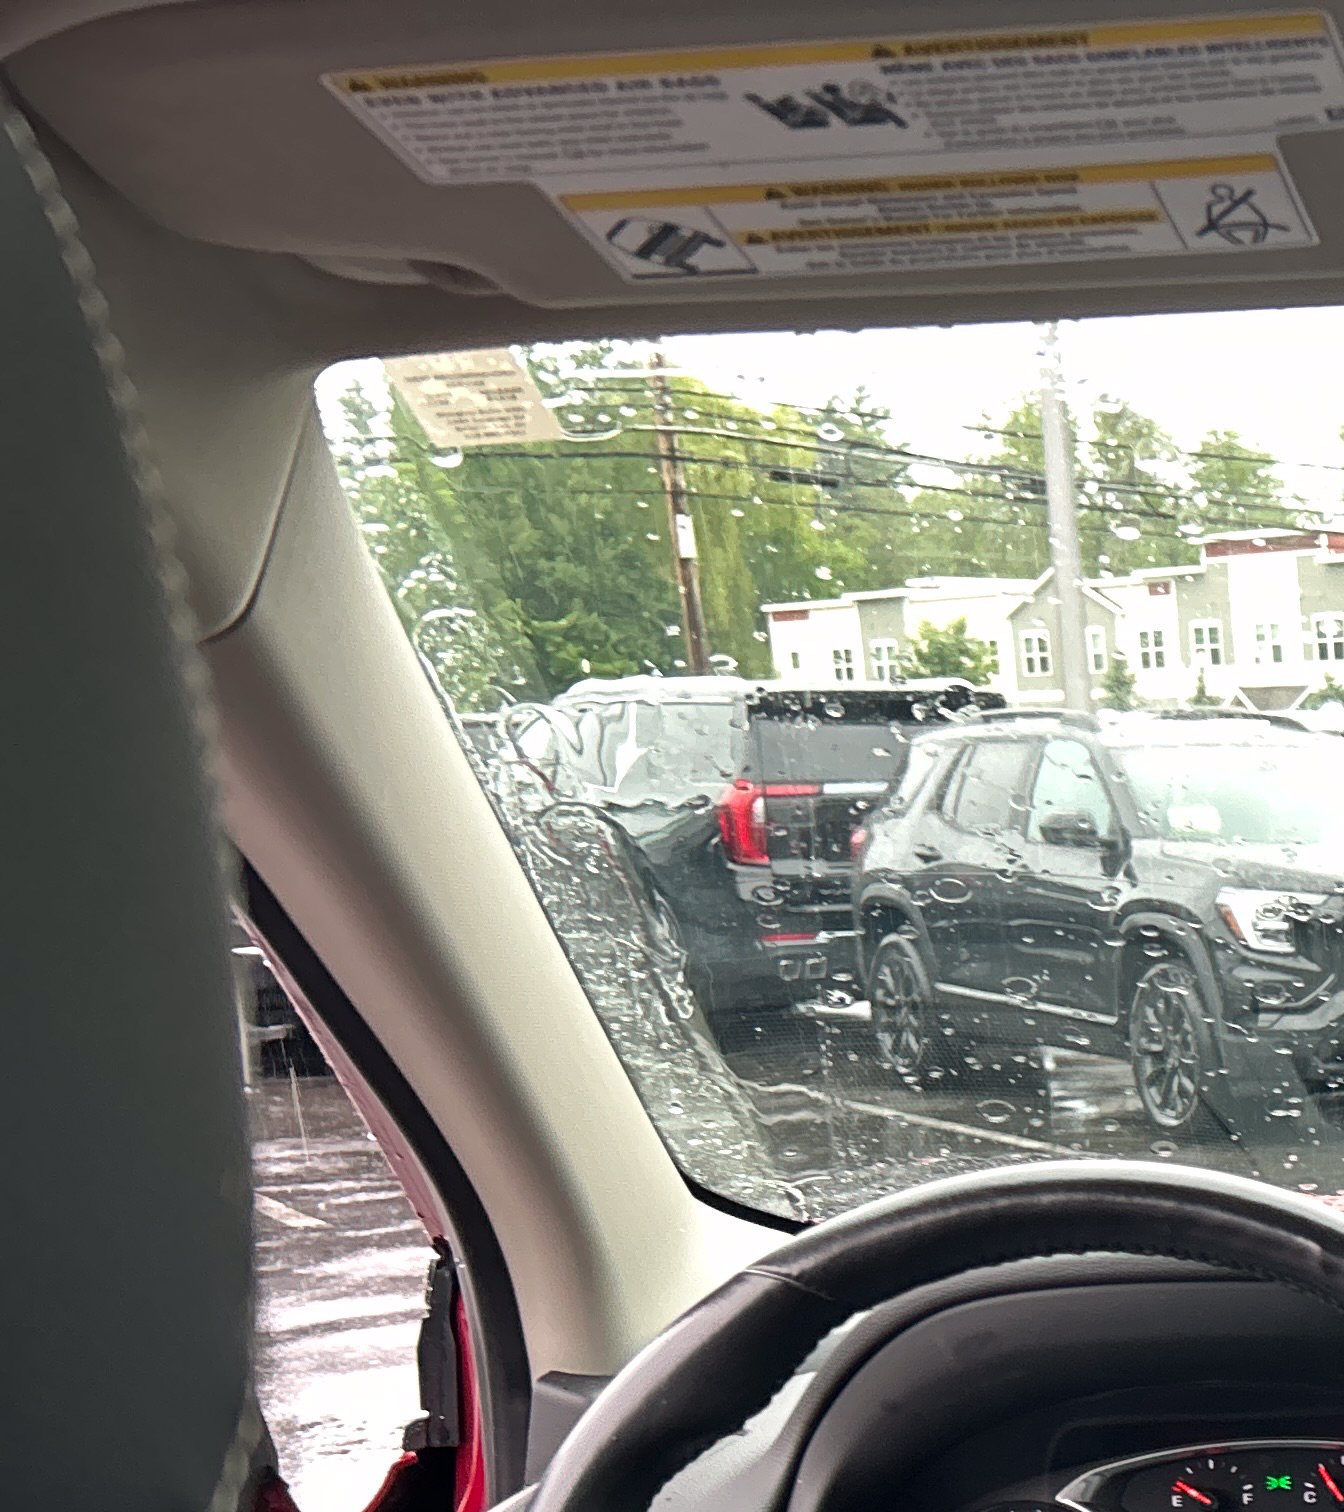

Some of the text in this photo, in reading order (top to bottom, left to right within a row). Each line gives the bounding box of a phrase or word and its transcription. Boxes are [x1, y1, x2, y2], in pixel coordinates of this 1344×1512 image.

[1171, 1495, 1183, 1508] E
[1242, 1493, 1254, 1505] F
[1303, 1491, 1317, 1504] C
